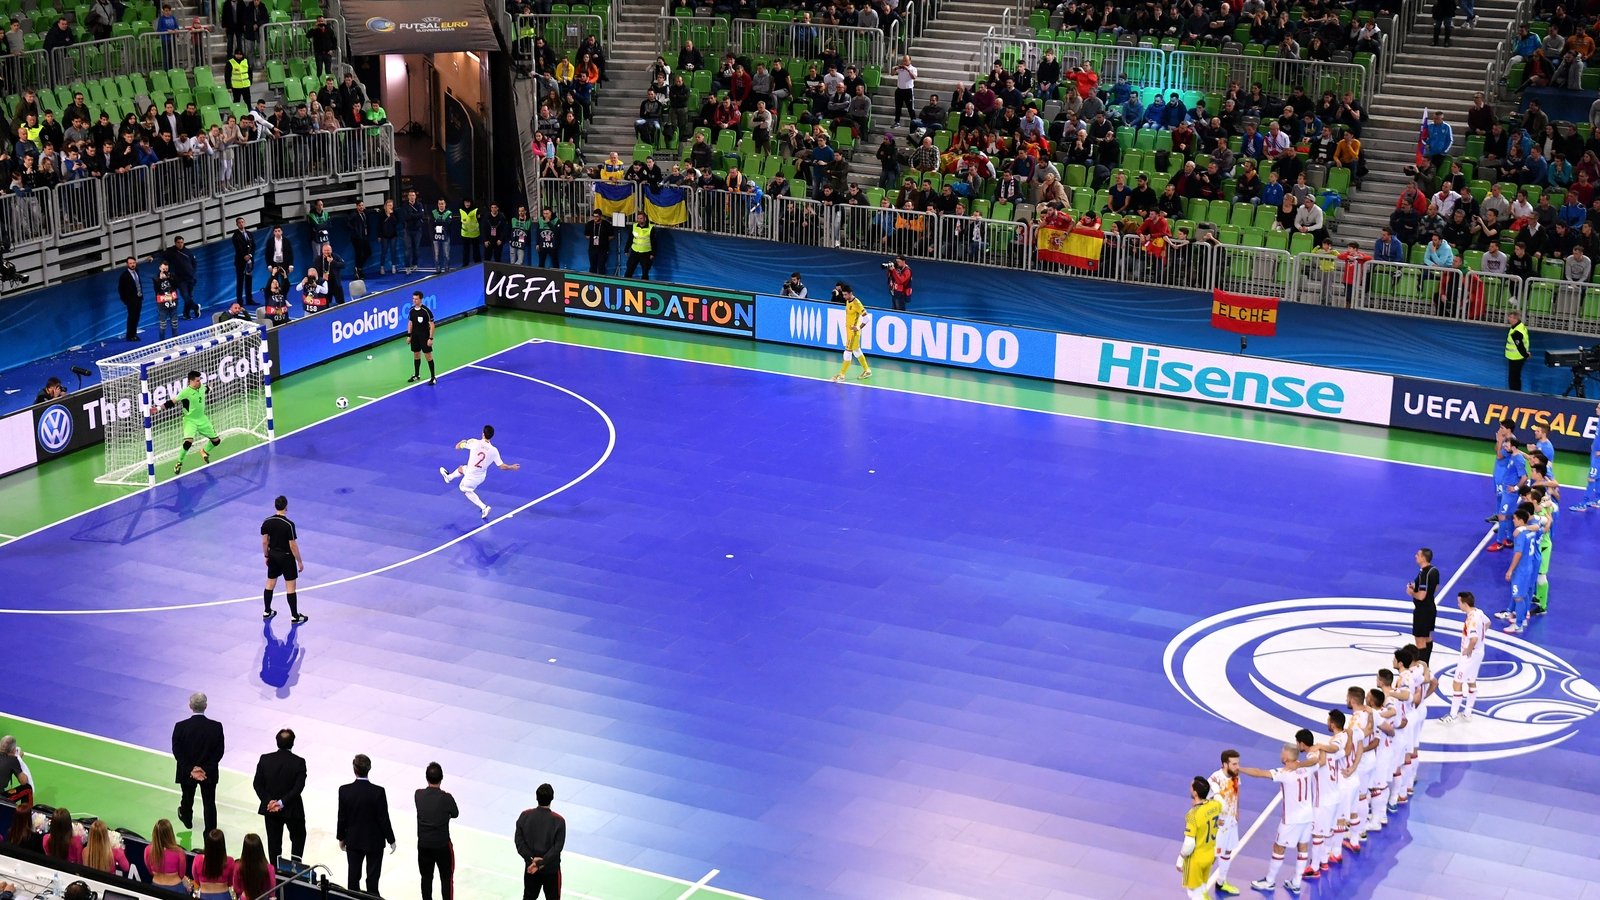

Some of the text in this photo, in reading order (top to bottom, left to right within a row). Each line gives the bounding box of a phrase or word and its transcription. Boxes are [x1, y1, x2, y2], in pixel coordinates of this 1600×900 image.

[331, 294, 437, 344] Booking.cm
[485, 270, 754, 329] UEFA FOUNDATION
[1218, 303, 1270, 323] ELCHE
[826, 307, 1020, 369] MONDO
[1097, 342, 1345, 414] Hisense
[83, 397, 131, 430] The
[1403, 392, 1481, 424] UEFA
[1483, 403, 1581, 438] FUTSAL
[474, 451, 486, 469] 2
[1326, 757, 1336, 782] 5
[1296, 776, 1308, 803] 11
